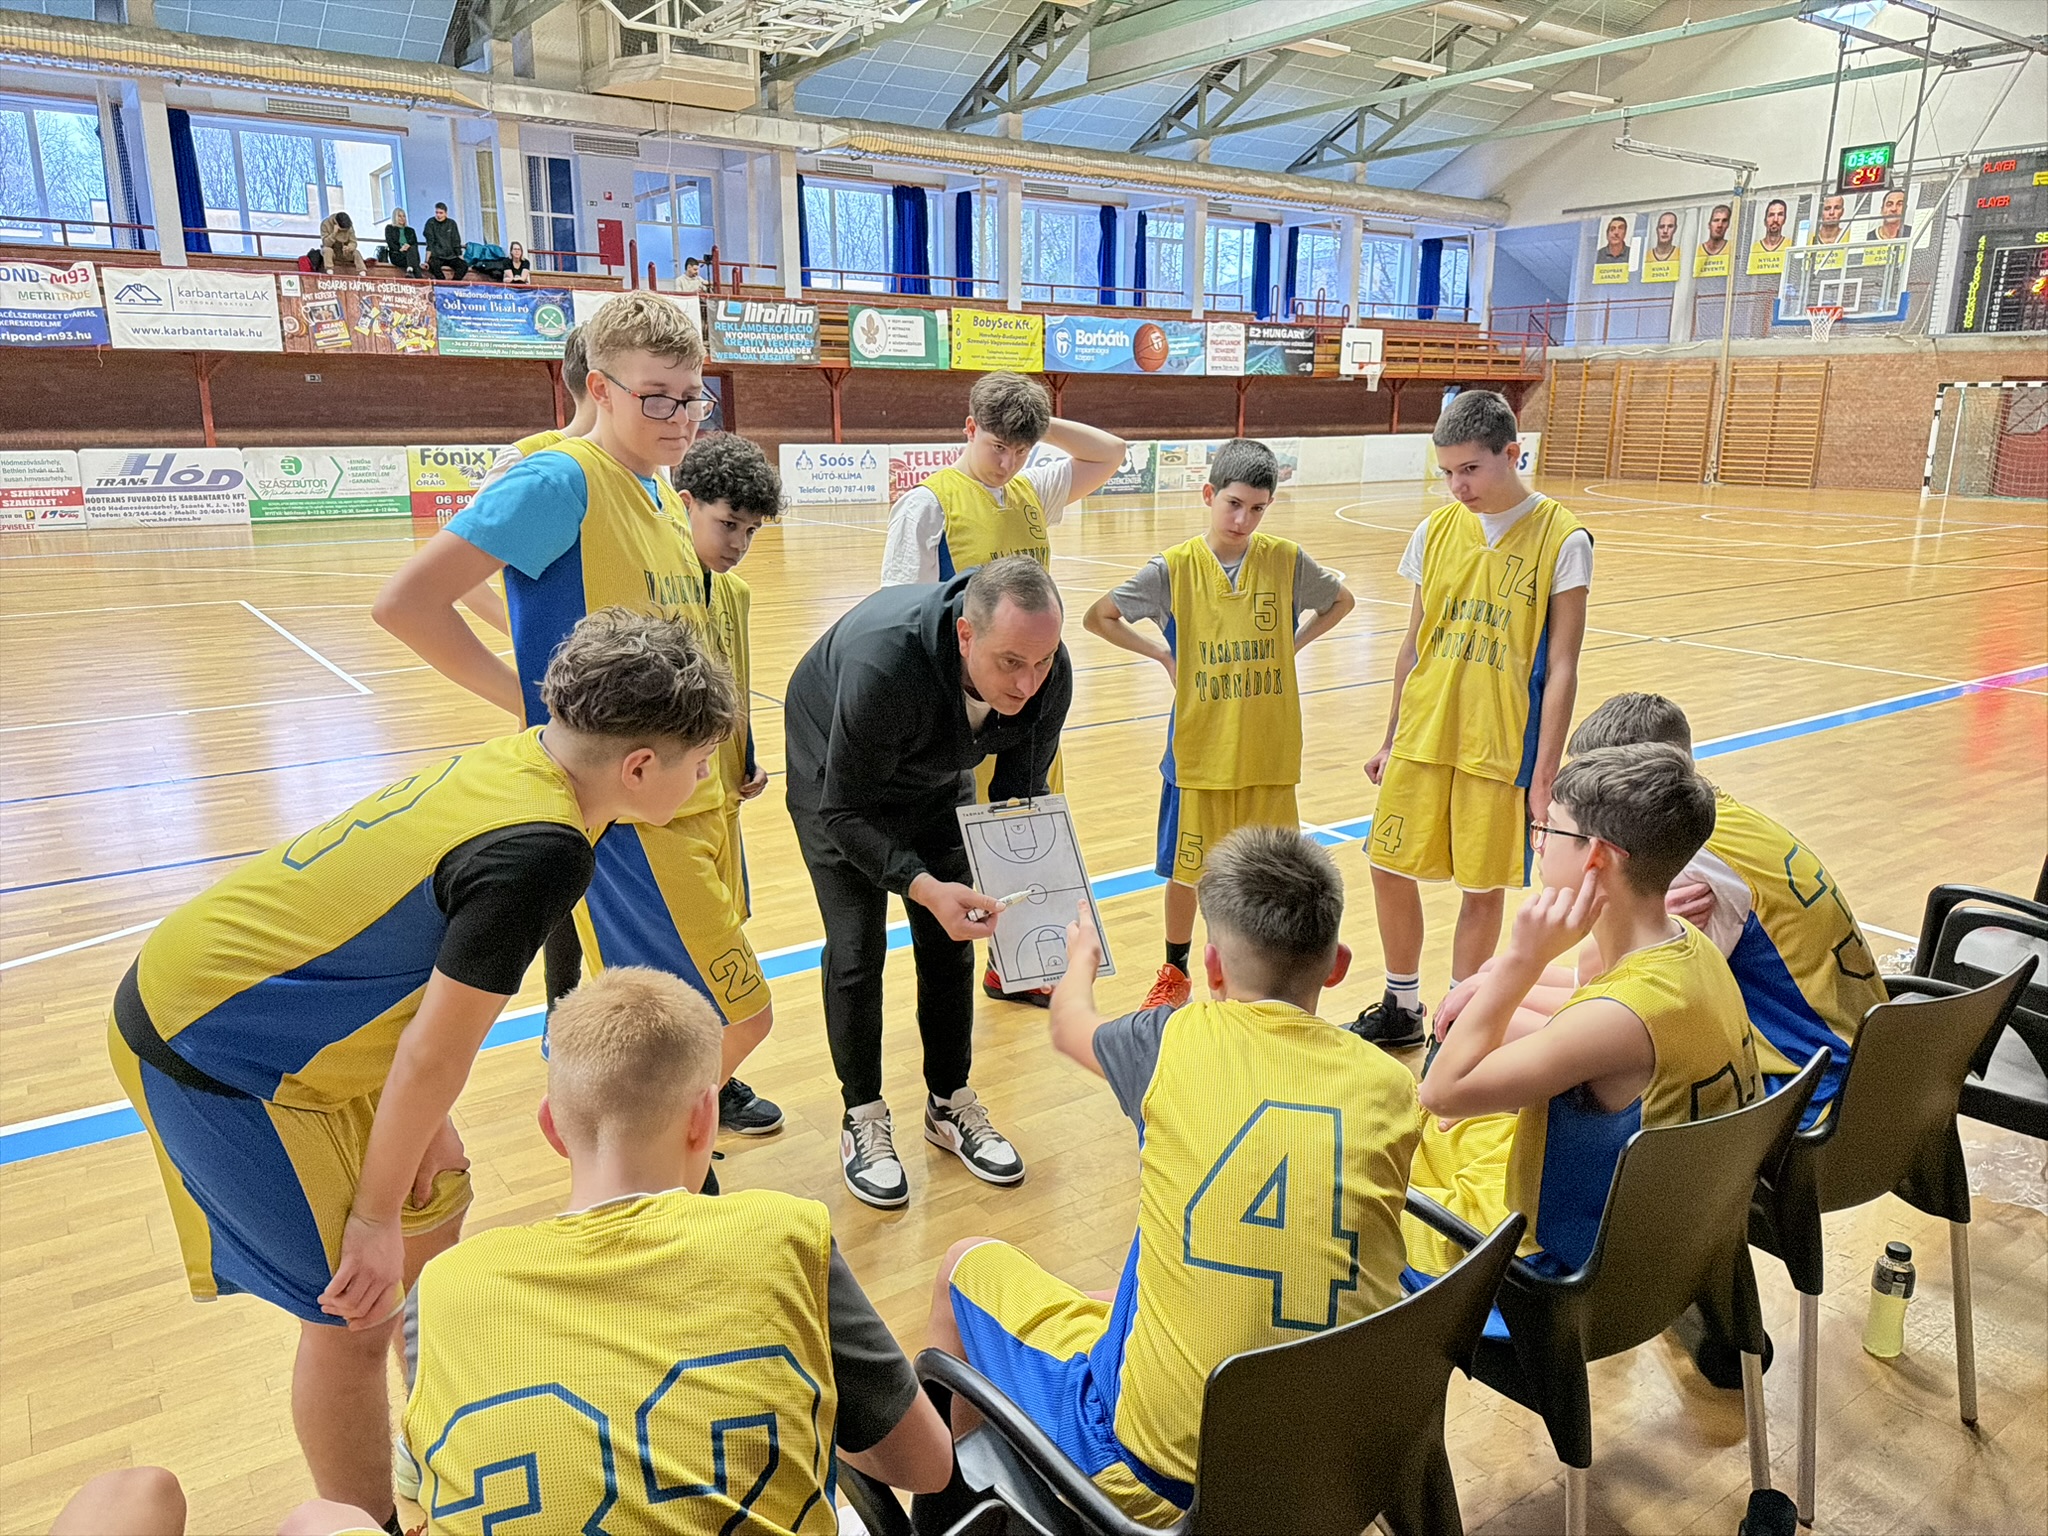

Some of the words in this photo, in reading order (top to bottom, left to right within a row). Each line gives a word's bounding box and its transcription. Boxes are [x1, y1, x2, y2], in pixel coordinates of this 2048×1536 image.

[1847, 152, 1885, 167] 03:26
[1983, 160, 2017, 173] PLAYER
[1852, 168, 1877, 185] 24
[1976, 195, 2011, 208] PLAYER
[177, 287, 269, 301] karbantartaLAK
[443, 298, 486, 314] Sólyom
[714, 321, 813, 334] REKLÁMDEKORÁCIÓ
[973, 315, 1014, 331] BobySec
[1015, 319, 1033, 331] Kft.
[131, 327, 262, 338] www.karbantartalak.hu
[1075, 329, 1130, 348] Borbáth
[1262, 328, 1305, 339] HUNGARY
[419, 448, 486, 467] Főnix
[819, 453, 855, 467] Soós
[3, 467, 27, 475] Bethlen
[95, 478, 149, 487] TRANS
[258, 477, 328, 489] SZÁSZBÚTOR
[10, 489, 70, 498] SZERELVÉNY
[798, 486, 827, 494] Telefon:
[828, 485, 843, 495] (30)
[844, 485, 876, 493] 787-4198
[85, 496, 126, 504] HÓDTRANS
[128, 495, 166, 503] FUVAROZÓ
[169, 494, 177, 502] ÉS
[179, 493, 230, 501] KARBANTARTÓ
[435, 495, 452, 505] 06
[1024, 504, 1047, 540] 9
[1497, 555, 1538, 607] 14
[1254, 592, 1278, 632] 5
[1195, 667, 1283, 702] TORNÁDÓK
[1374, 808, 1404, 854] 4
[1178, 831, 1204, 871] 5
[709, 940, 763, 1004] 2
[1183, 1098, 1359, 1333] 4
